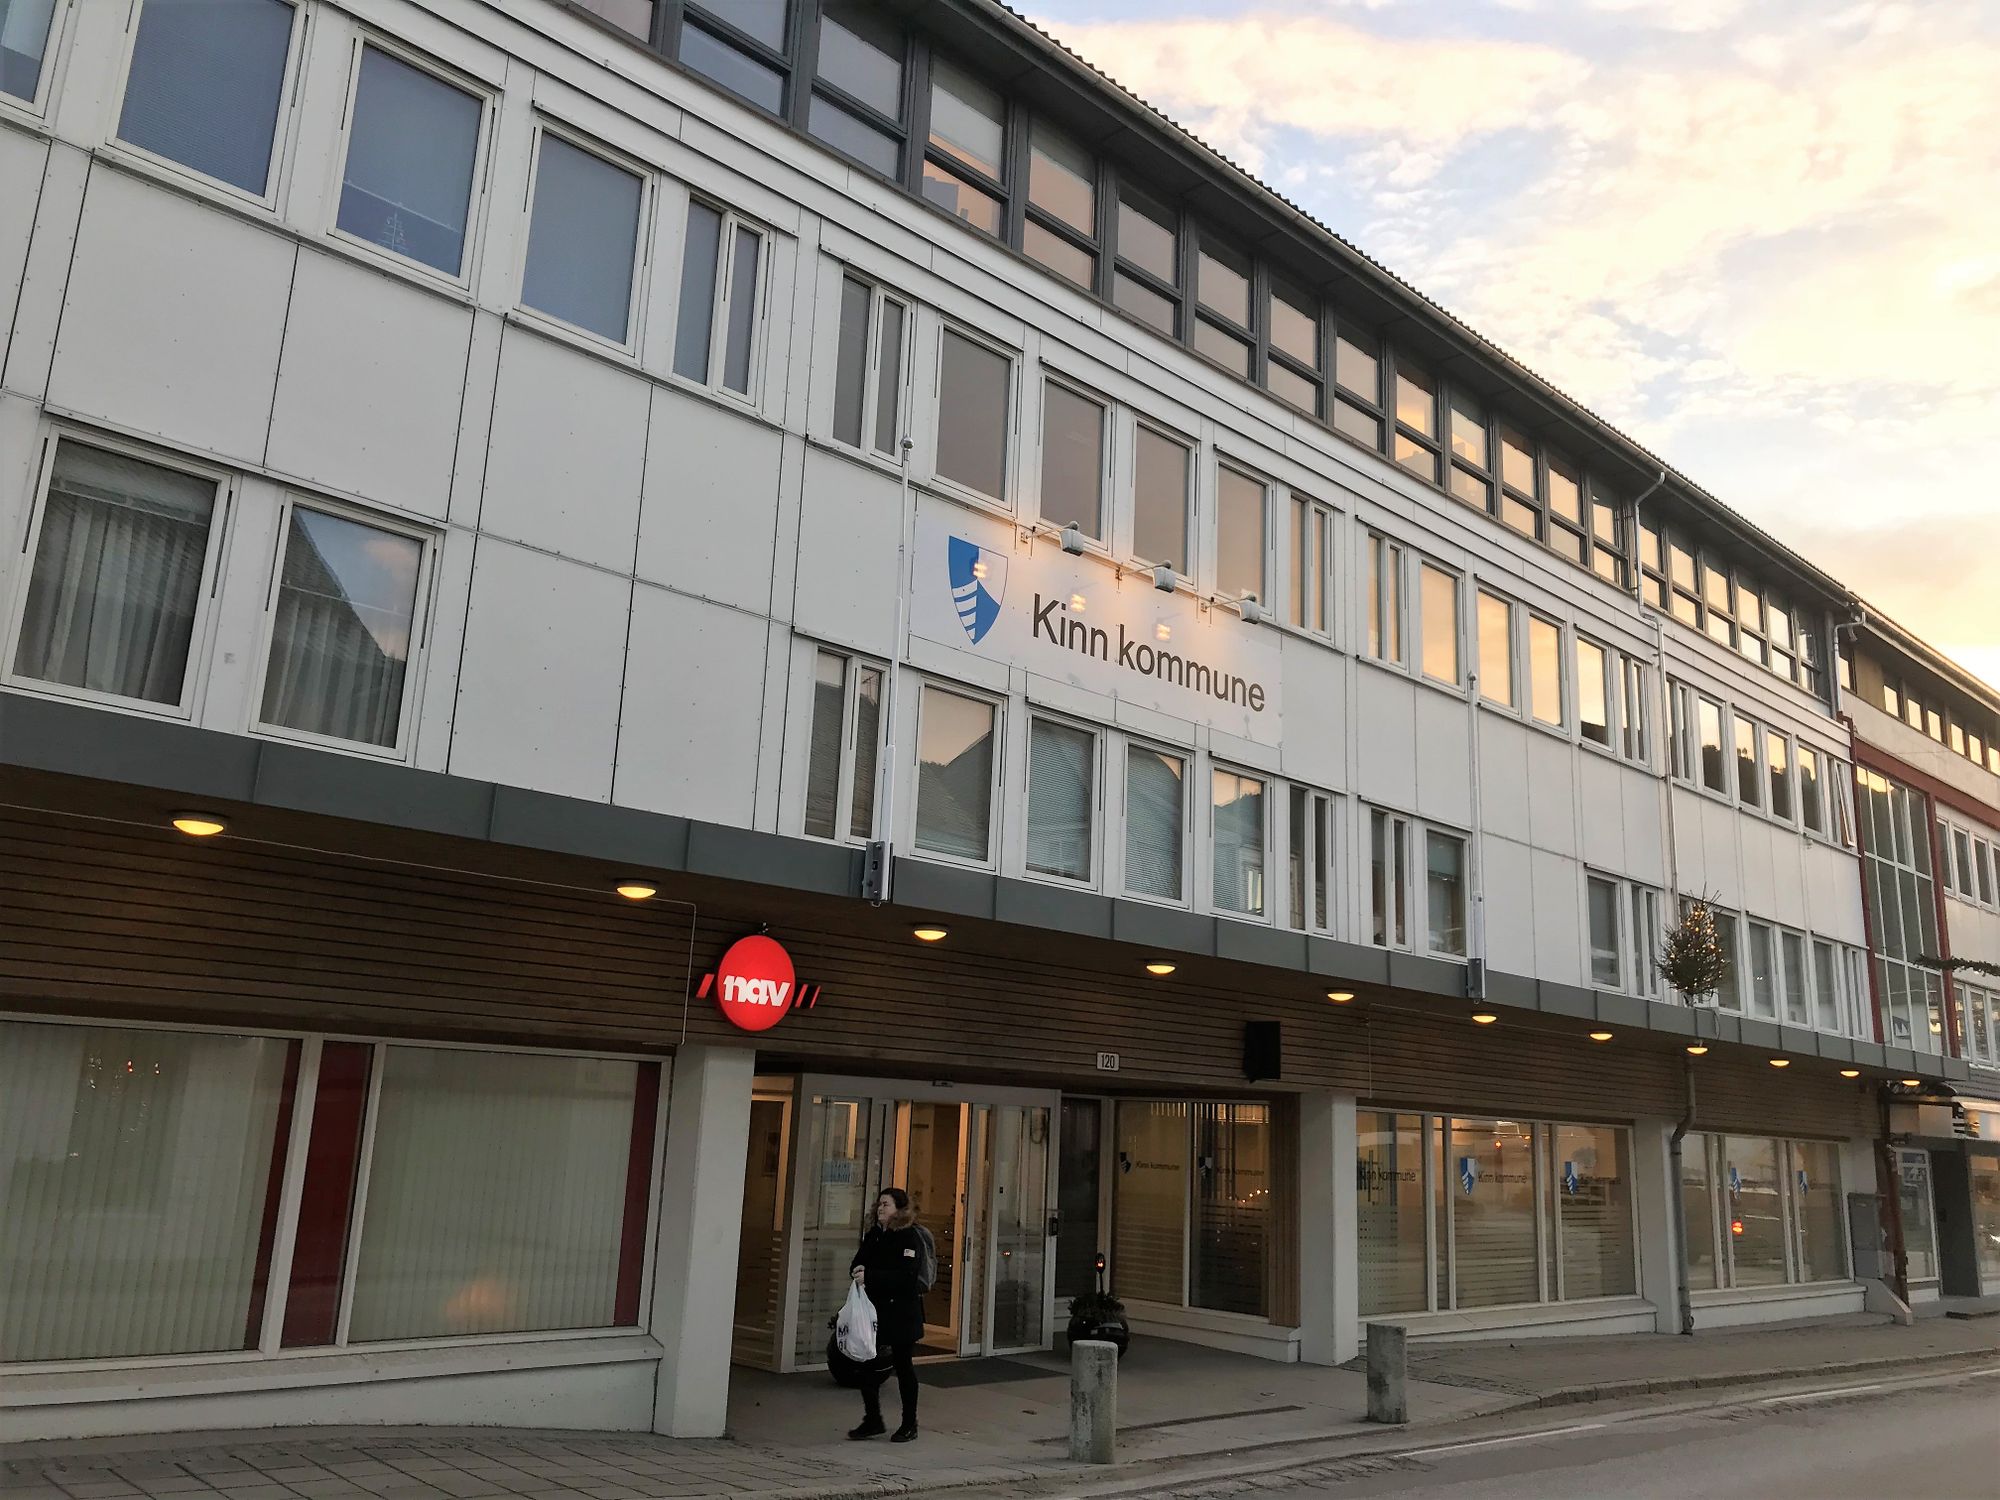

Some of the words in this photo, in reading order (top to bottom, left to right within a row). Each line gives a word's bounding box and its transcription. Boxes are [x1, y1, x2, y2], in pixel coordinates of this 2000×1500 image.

[1032, 592, 1108, 661] Kinn
[1118, 623, 1265, 712] kommune
[723, 975, 791, 1007] nav
[1100, 1054, 1115, 1069] 120
